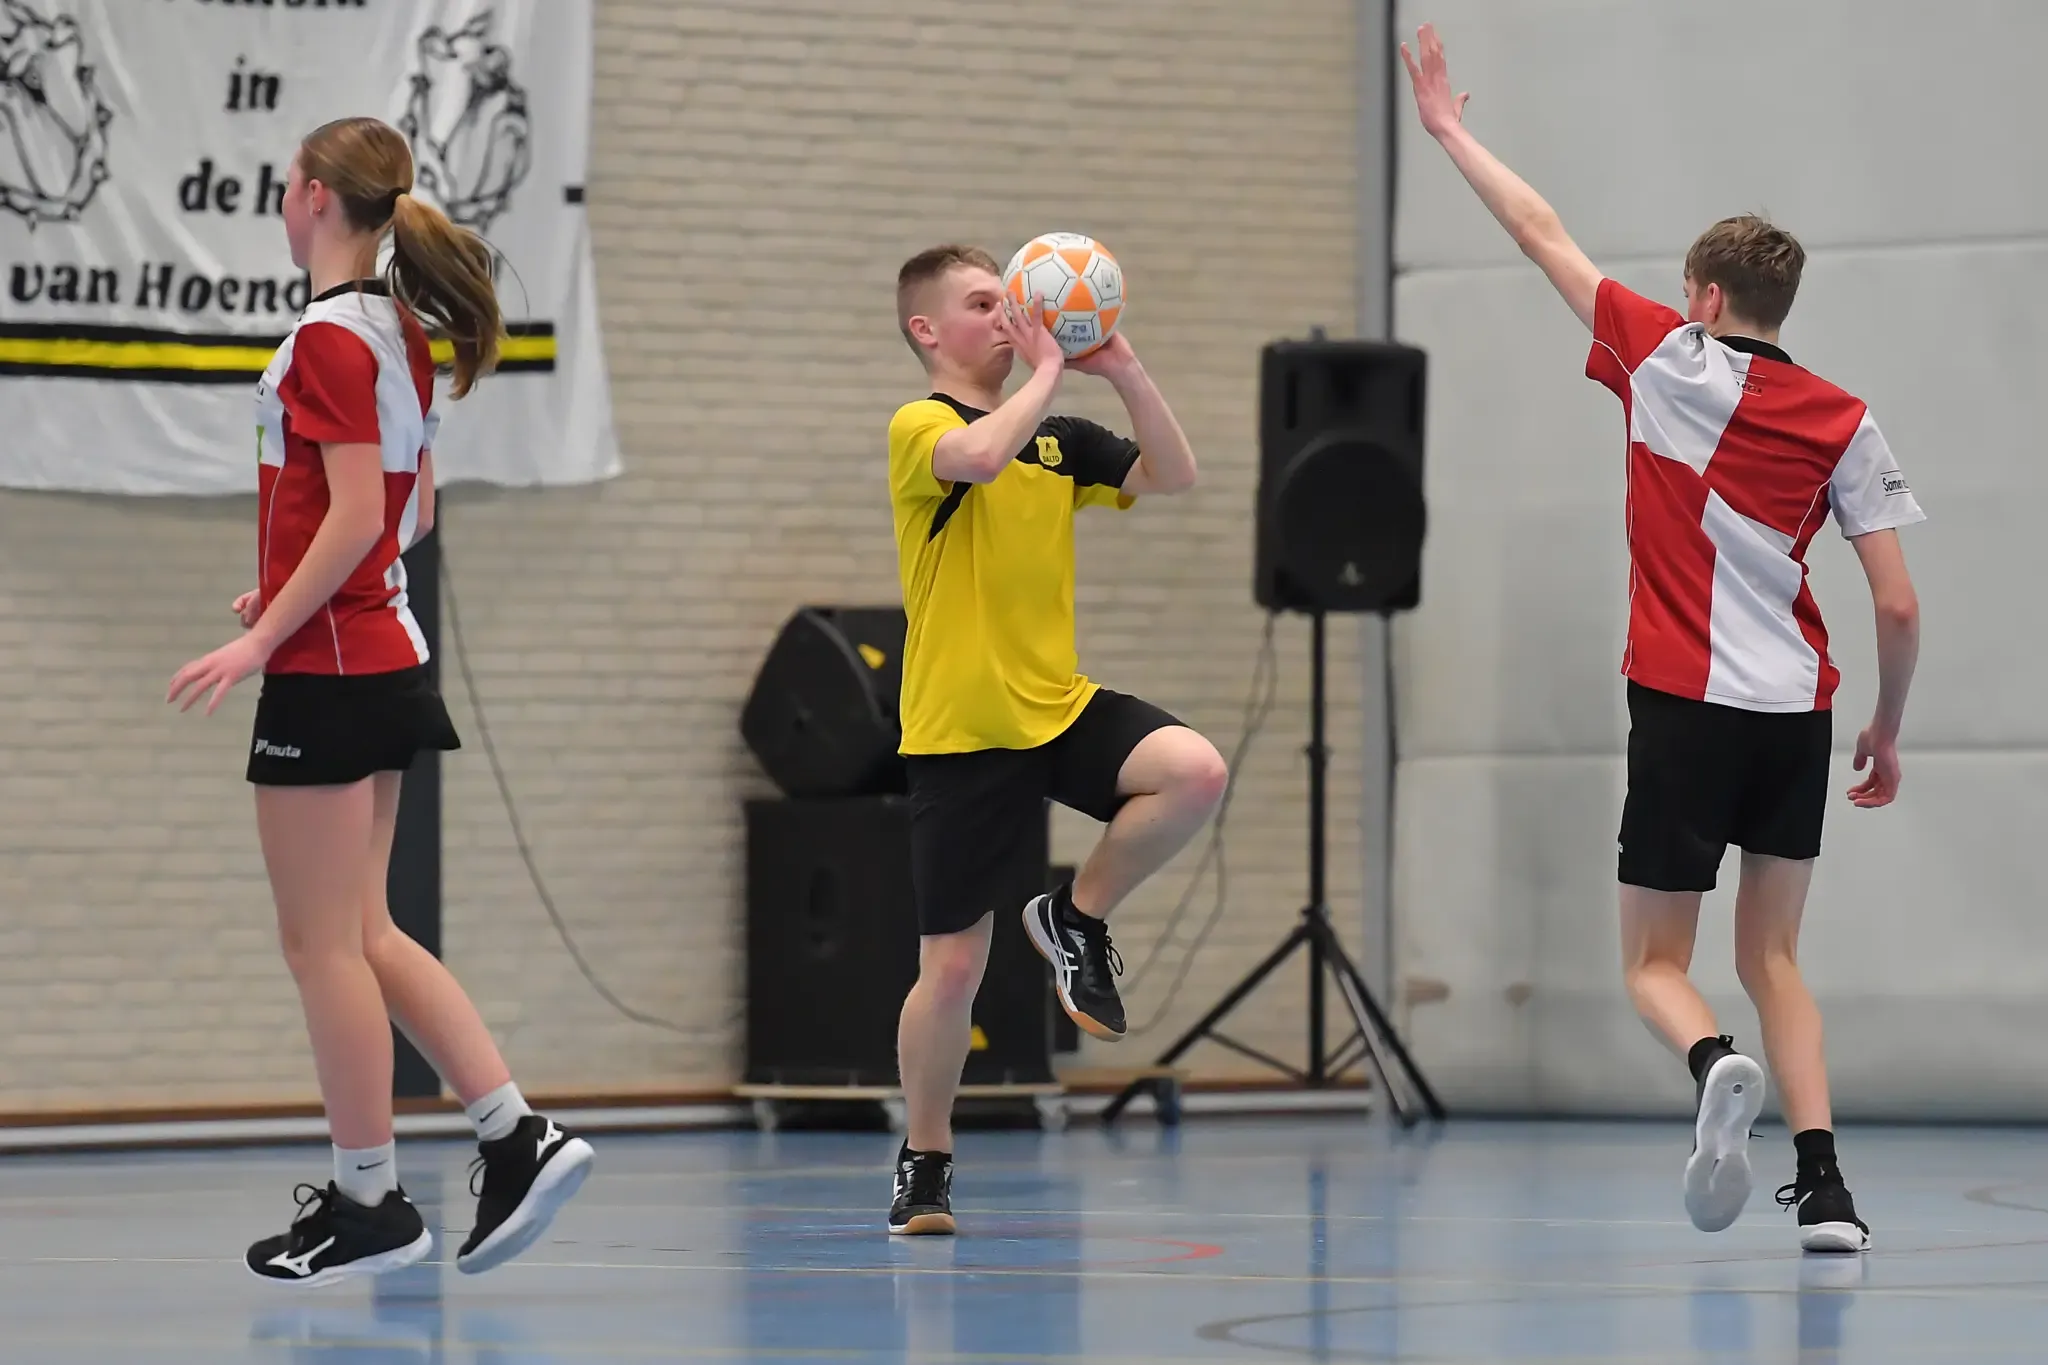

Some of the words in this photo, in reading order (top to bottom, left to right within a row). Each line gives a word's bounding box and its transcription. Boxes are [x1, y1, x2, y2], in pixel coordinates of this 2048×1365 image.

[225, 55, 280, 111] in
[180, 158, 241, 213] de
[10, 263, 119, 304] van
[134, 262, 312, 313] Hoend
[266, 744, 302, 758] muta
